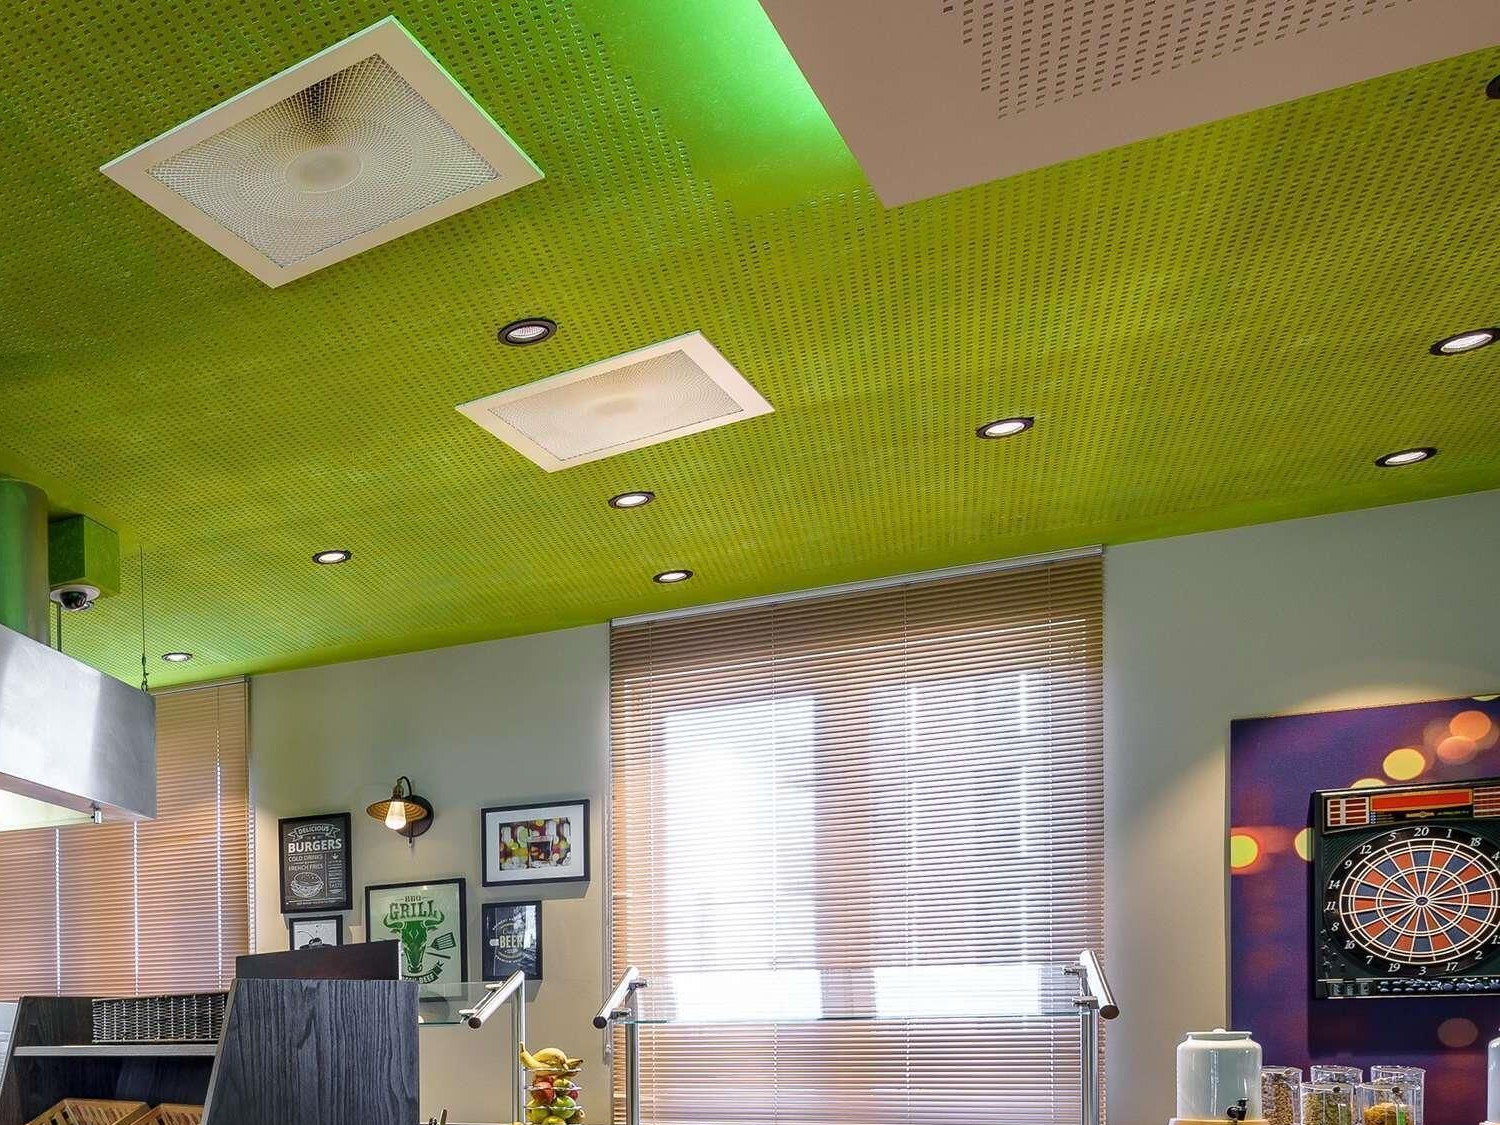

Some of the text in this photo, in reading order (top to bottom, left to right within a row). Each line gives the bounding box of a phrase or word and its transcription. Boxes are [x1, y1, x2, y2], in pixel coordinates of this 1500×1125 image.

[299, 825, 330, 835] DELICIOUS
[1413, 826, 1430, 837] 20
[1446, 828, 1453, 838] 1
[1388, 832, 1397, 842] 5
[1470, 837, 1482, 847] 18
[288, 839, 342, 853] BURGERS
[1360, 845, 1372, 854] 12
[1344, 860, 1352, 869] 9
[1328, 880, 1341, 890] 14
[389, 900, 438, 920] GRILL
[1324, 901, 1336, 912] 11
[1331, 922, 1340, 932] 8
[499, 935, 524, 948] BEER
[1344, 940, 1355, 950] 16
[1365, 955, 1374, 965] 7
[1475, 950, 1483, 960] 2
[1388, 963, 1401, 973] 19
[1418, 966, 1427, 976] 3
[1445, 962, 1458, 972] 17
